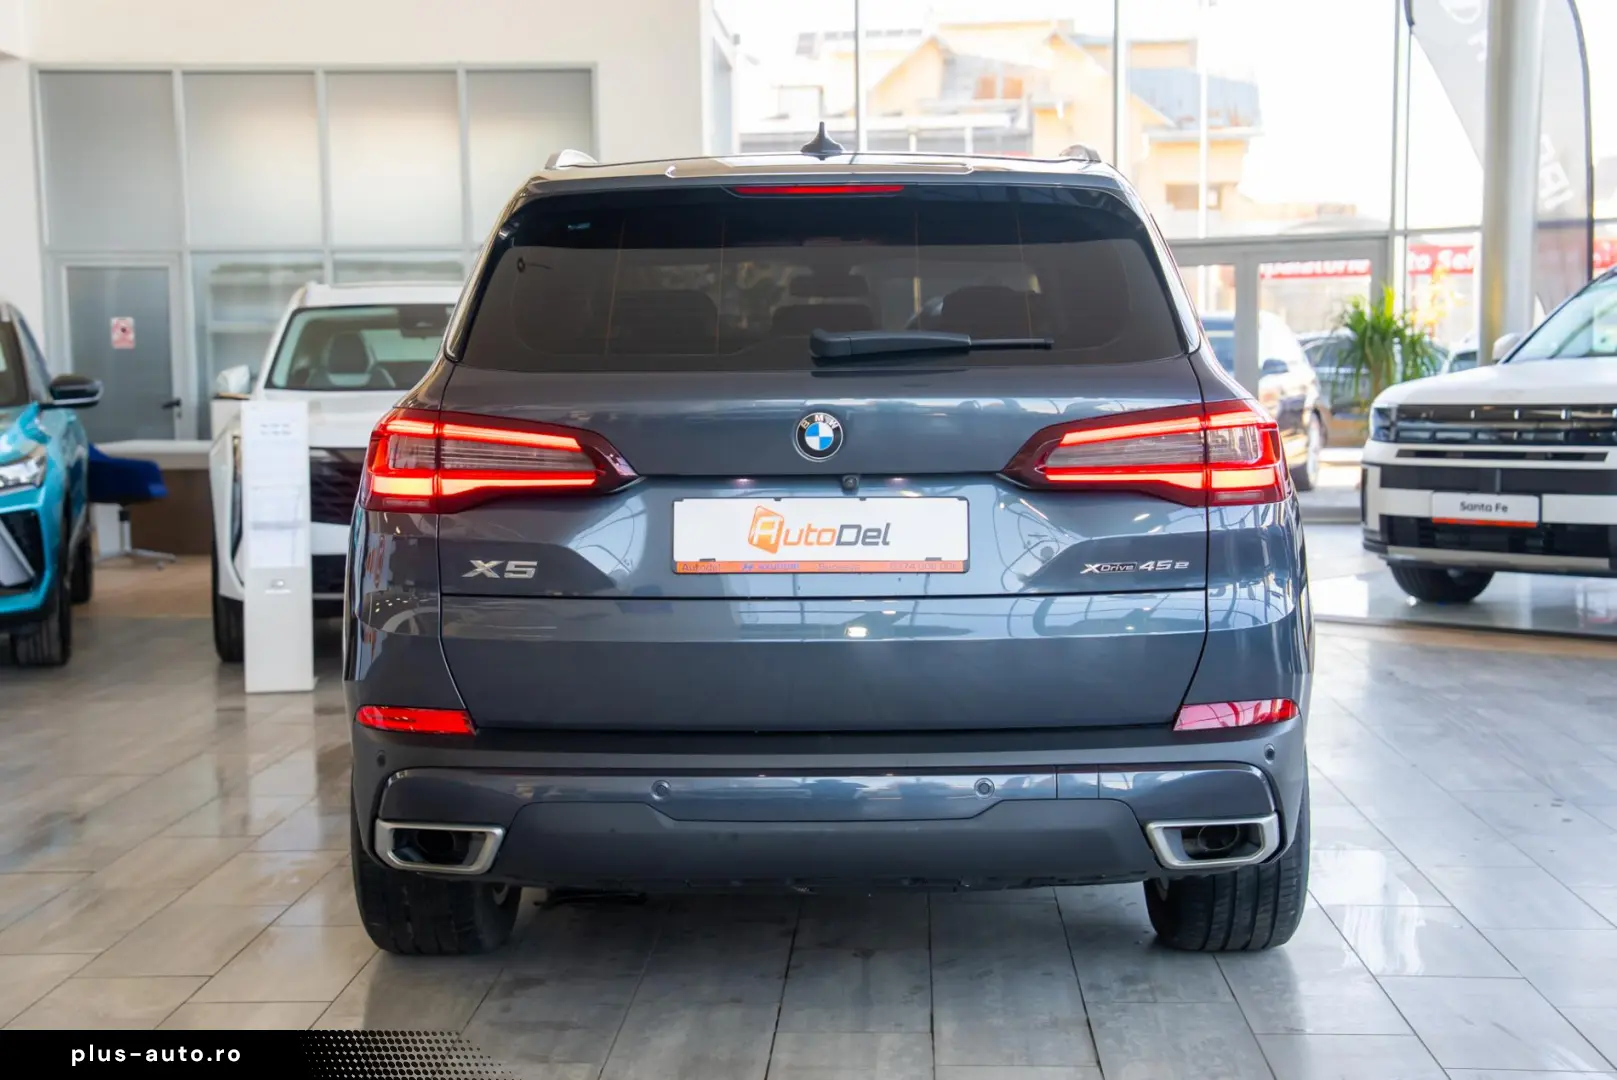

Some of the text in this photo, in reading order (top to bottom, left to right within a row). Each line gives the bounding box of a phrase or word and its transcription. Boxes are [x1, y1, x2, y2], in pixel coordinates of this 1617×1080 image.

[800, 414, 839, 430] BMW
[1460, 501, 1509, 513] Santa Fe
[748, 505, 891, 554] AutoDel
[461, 559, 538, 579] X5
